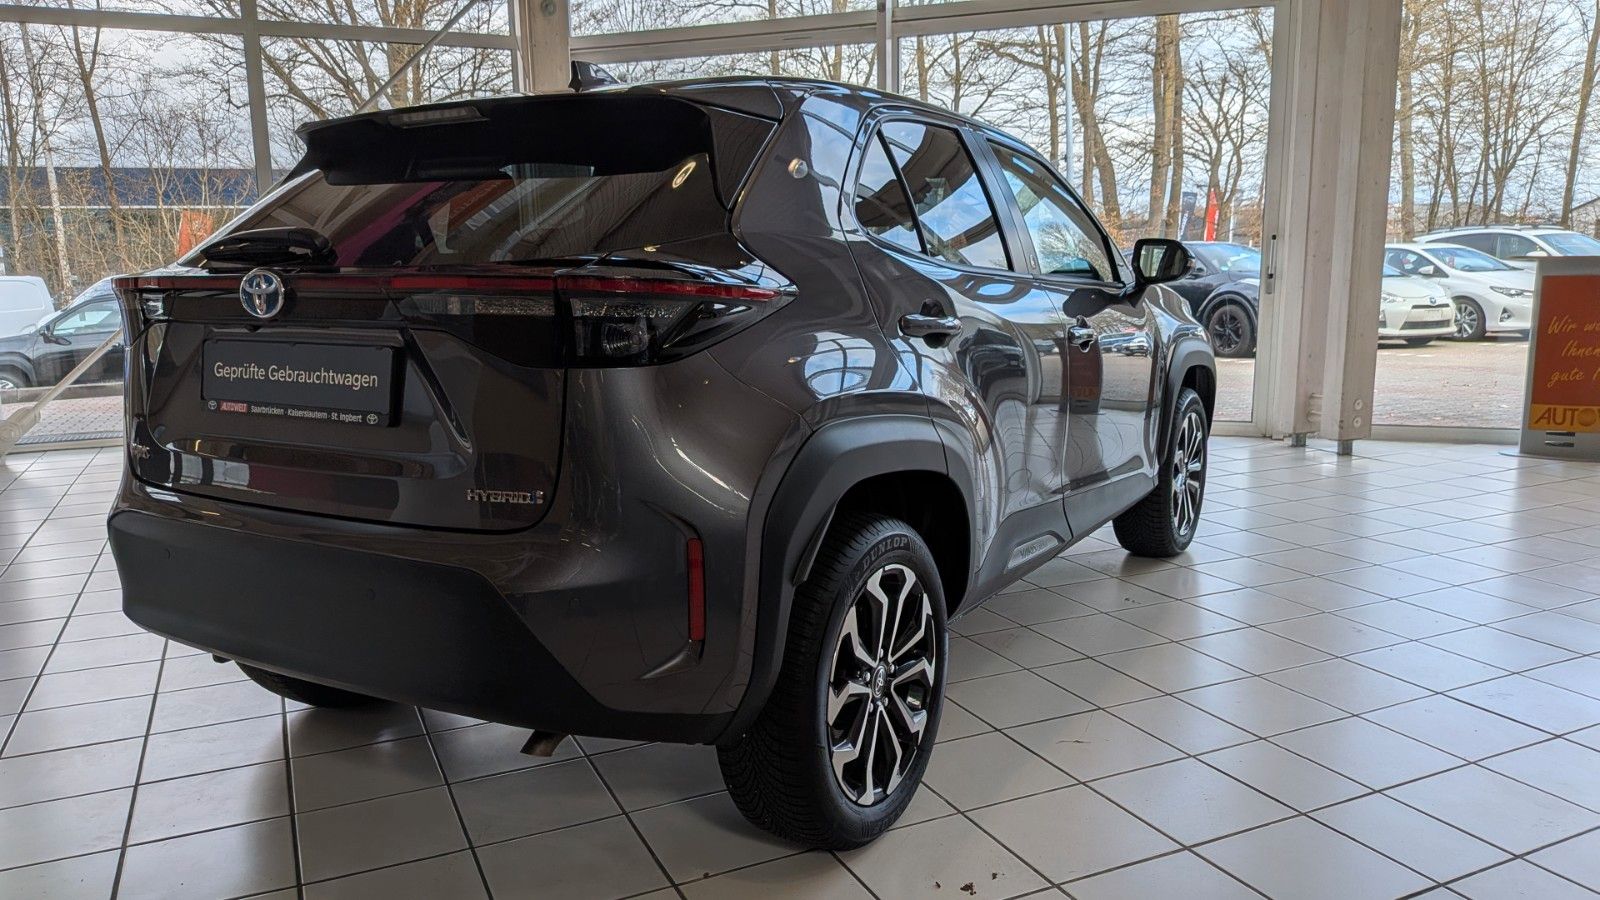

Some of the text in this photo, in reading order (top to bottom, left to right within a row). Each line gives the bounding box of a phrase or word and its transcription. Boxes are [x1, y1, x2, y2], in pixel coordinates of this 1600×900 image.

[1548, 315, 1576, 334] Wir
[214, 361, 378, 390] Geprüfte Gebrauchtwagen
[1547, 367, 1584, 388] gute
[250, 405, 284, 416] Saarbrücken
[287, 408, 328, 419] Kaiserslautern
[340, 412, 362, 423] Ingbert
[466, 489, 532, 504] HYBRID
[863, 537, 908, 569] DUNLOP
